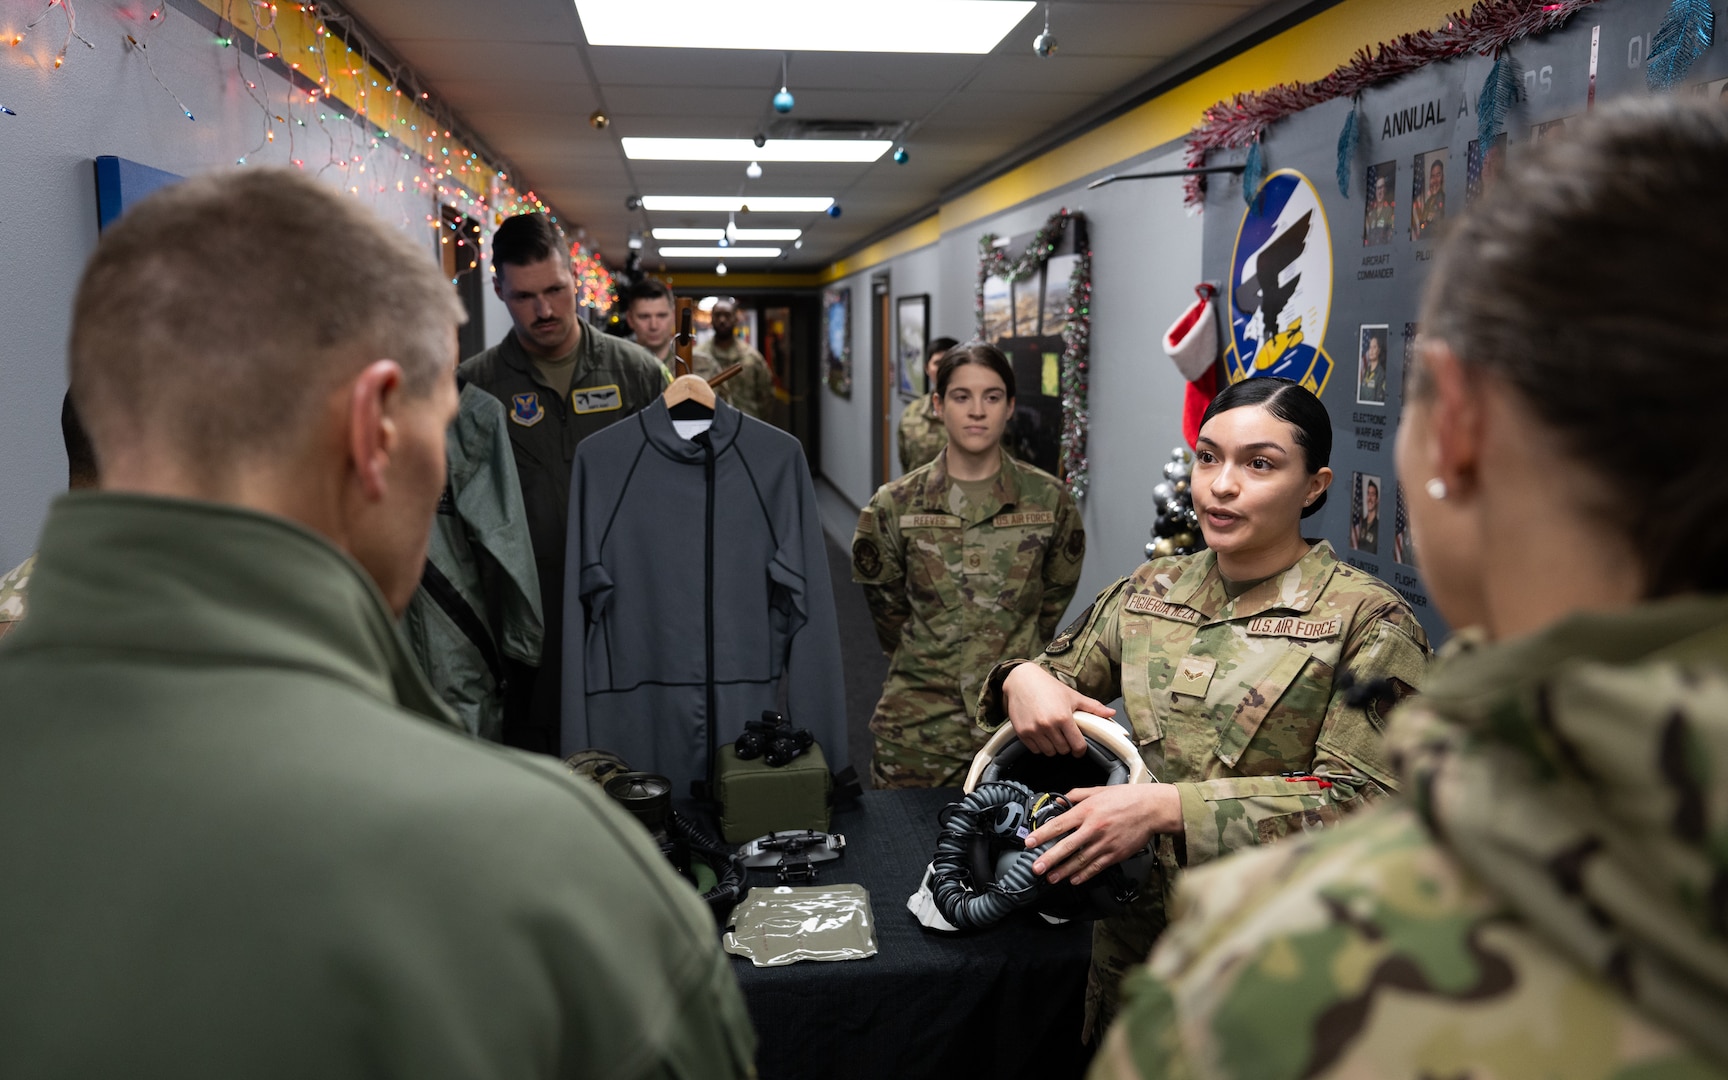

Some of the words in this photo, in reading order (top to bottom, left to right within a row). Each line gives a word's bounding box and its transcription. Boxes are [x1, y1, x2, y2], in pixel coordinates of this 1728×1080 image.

[1382, 99, 1446, 140] ANNUAL
[1362, 254, 1390, 266] AIRCRAFT
[1357, 267, 1394, 280] COMMANDER
[1352, 412, 1387, 426] ELECTRONIC
[1355, 426, 1383, 440] WARFARE
[1356, 439, 1380, 452] OFFICER
[914, 516, 947, 526] REEVES
[1011, 514, 1024, 524] AIR
[1025, 513, 1051, 523] FORCE
[1395, 572, 1417, 589] FLIGHT
[1128, 595, 1171, 614] FIGUEROA
[1170, 604, 1196, 621] MEZA
[1251, 618, 1272, 633] U.S.
[1273, 618, 1293, 634] AIR
[1295, 620, 1336, 637] FORCE
